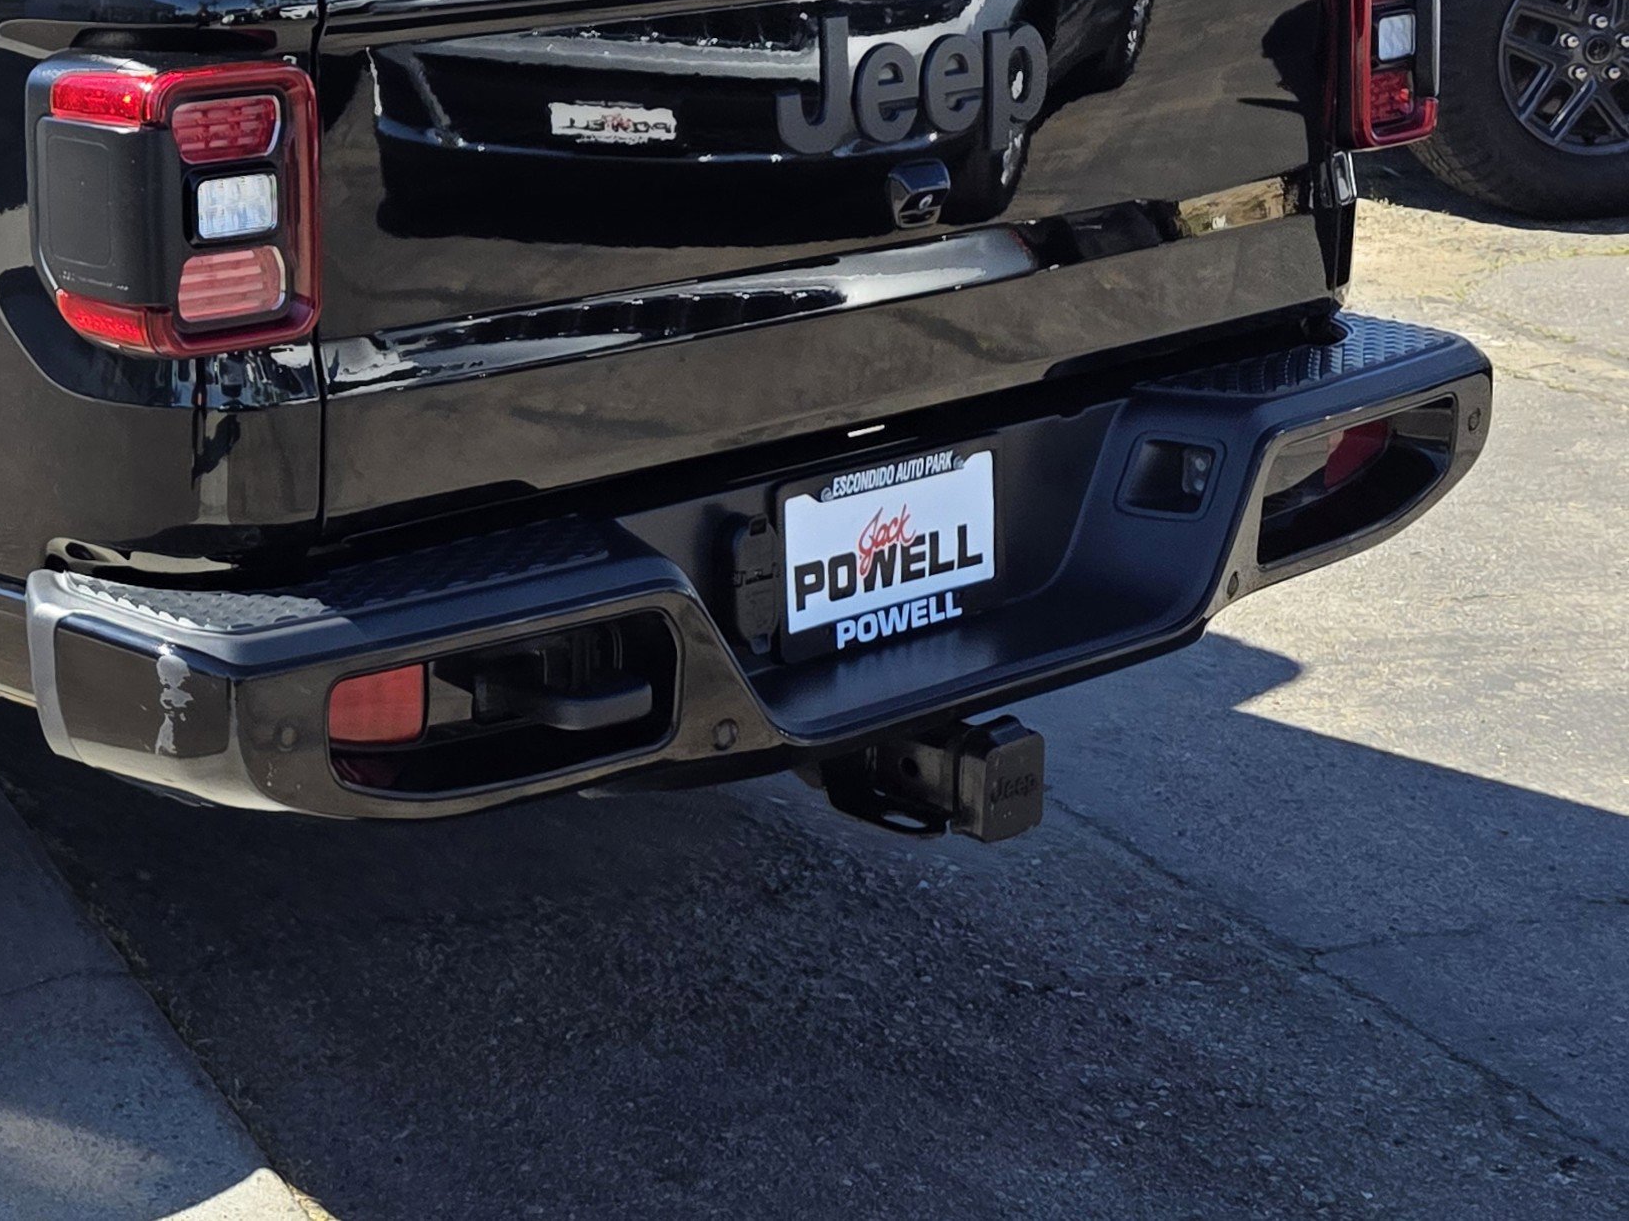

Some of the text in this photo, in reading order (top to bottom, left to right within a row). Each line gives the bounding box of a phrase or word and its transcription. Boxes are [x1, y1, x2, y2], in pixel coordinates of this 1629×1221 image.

[776, 16, 1048, 154] Jeep
[832, 450, 953, 497] ESCONDIDO AUTO PARK
[794, 524, 984, 612] POWELL
[858, 504, 916, 576] Jack
[836, 591, 963, 650] POWELL
